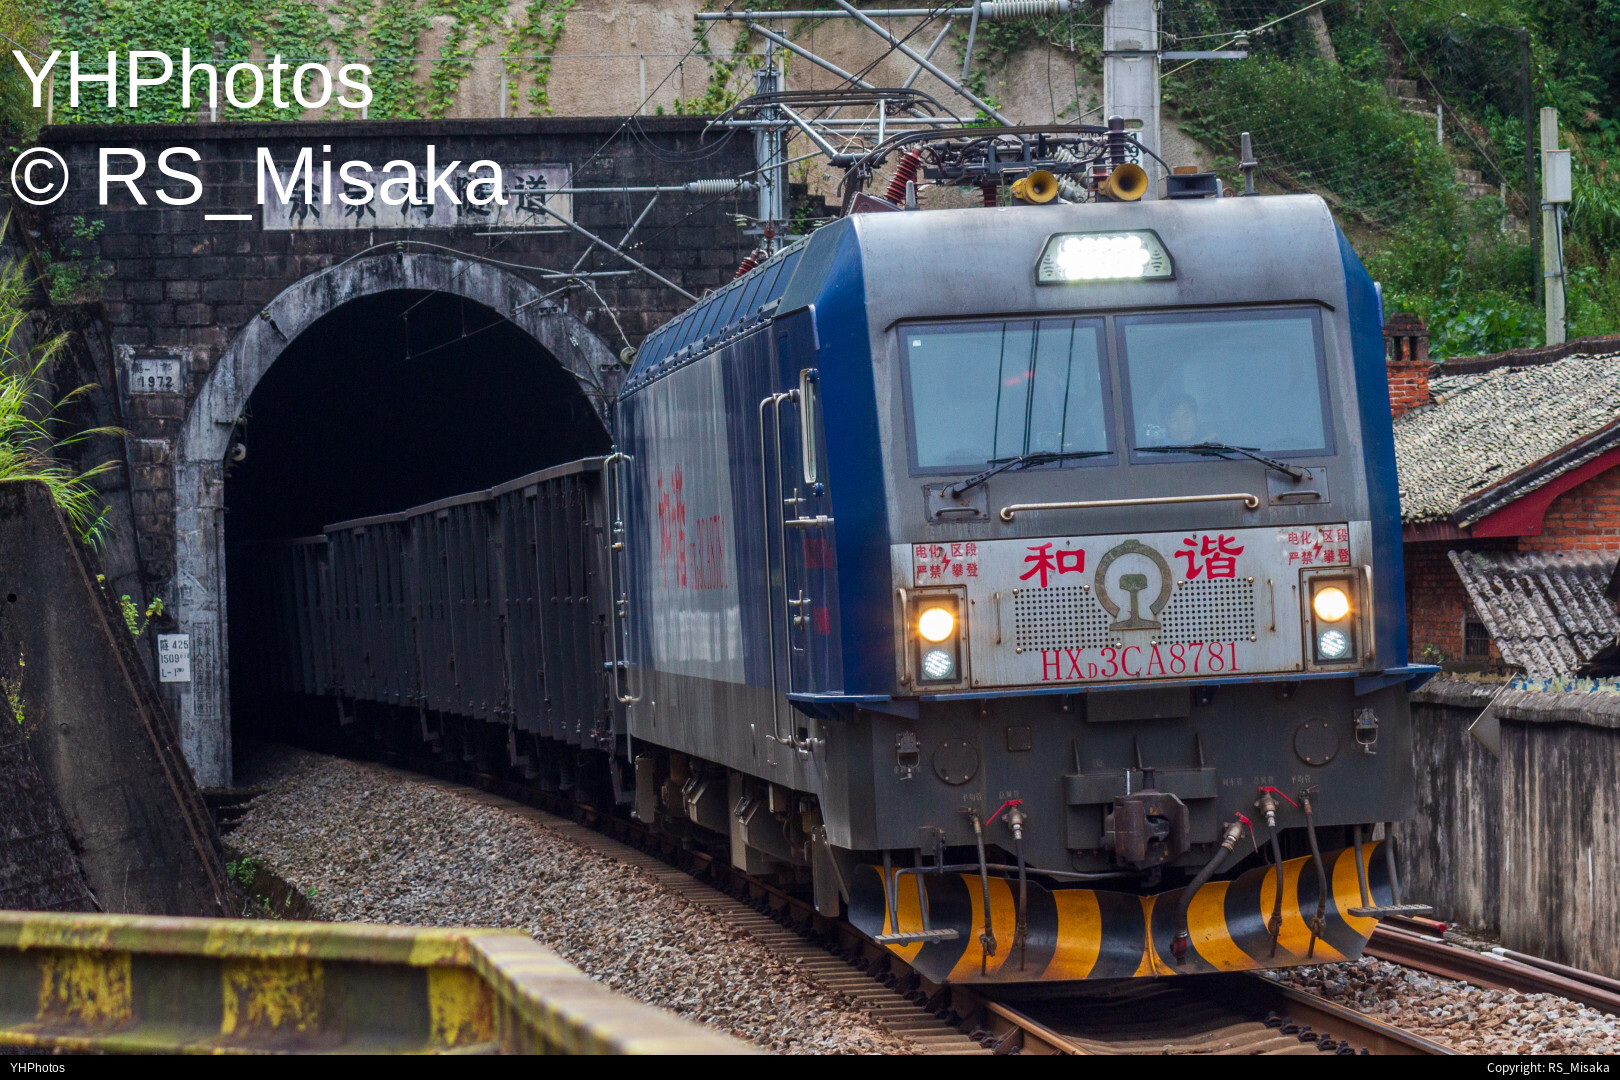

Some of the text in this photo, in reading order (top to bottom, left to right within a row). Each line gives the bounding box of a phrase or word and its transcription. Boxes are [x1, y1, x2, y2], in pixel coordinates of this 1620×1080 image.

[139, 376, 173, 388] 1972
[1019, 534, 1244, 588] 和 谐
[172, 640, 188, 649] 425
[1041, 641, 1241, 681] HXD3CA8781
